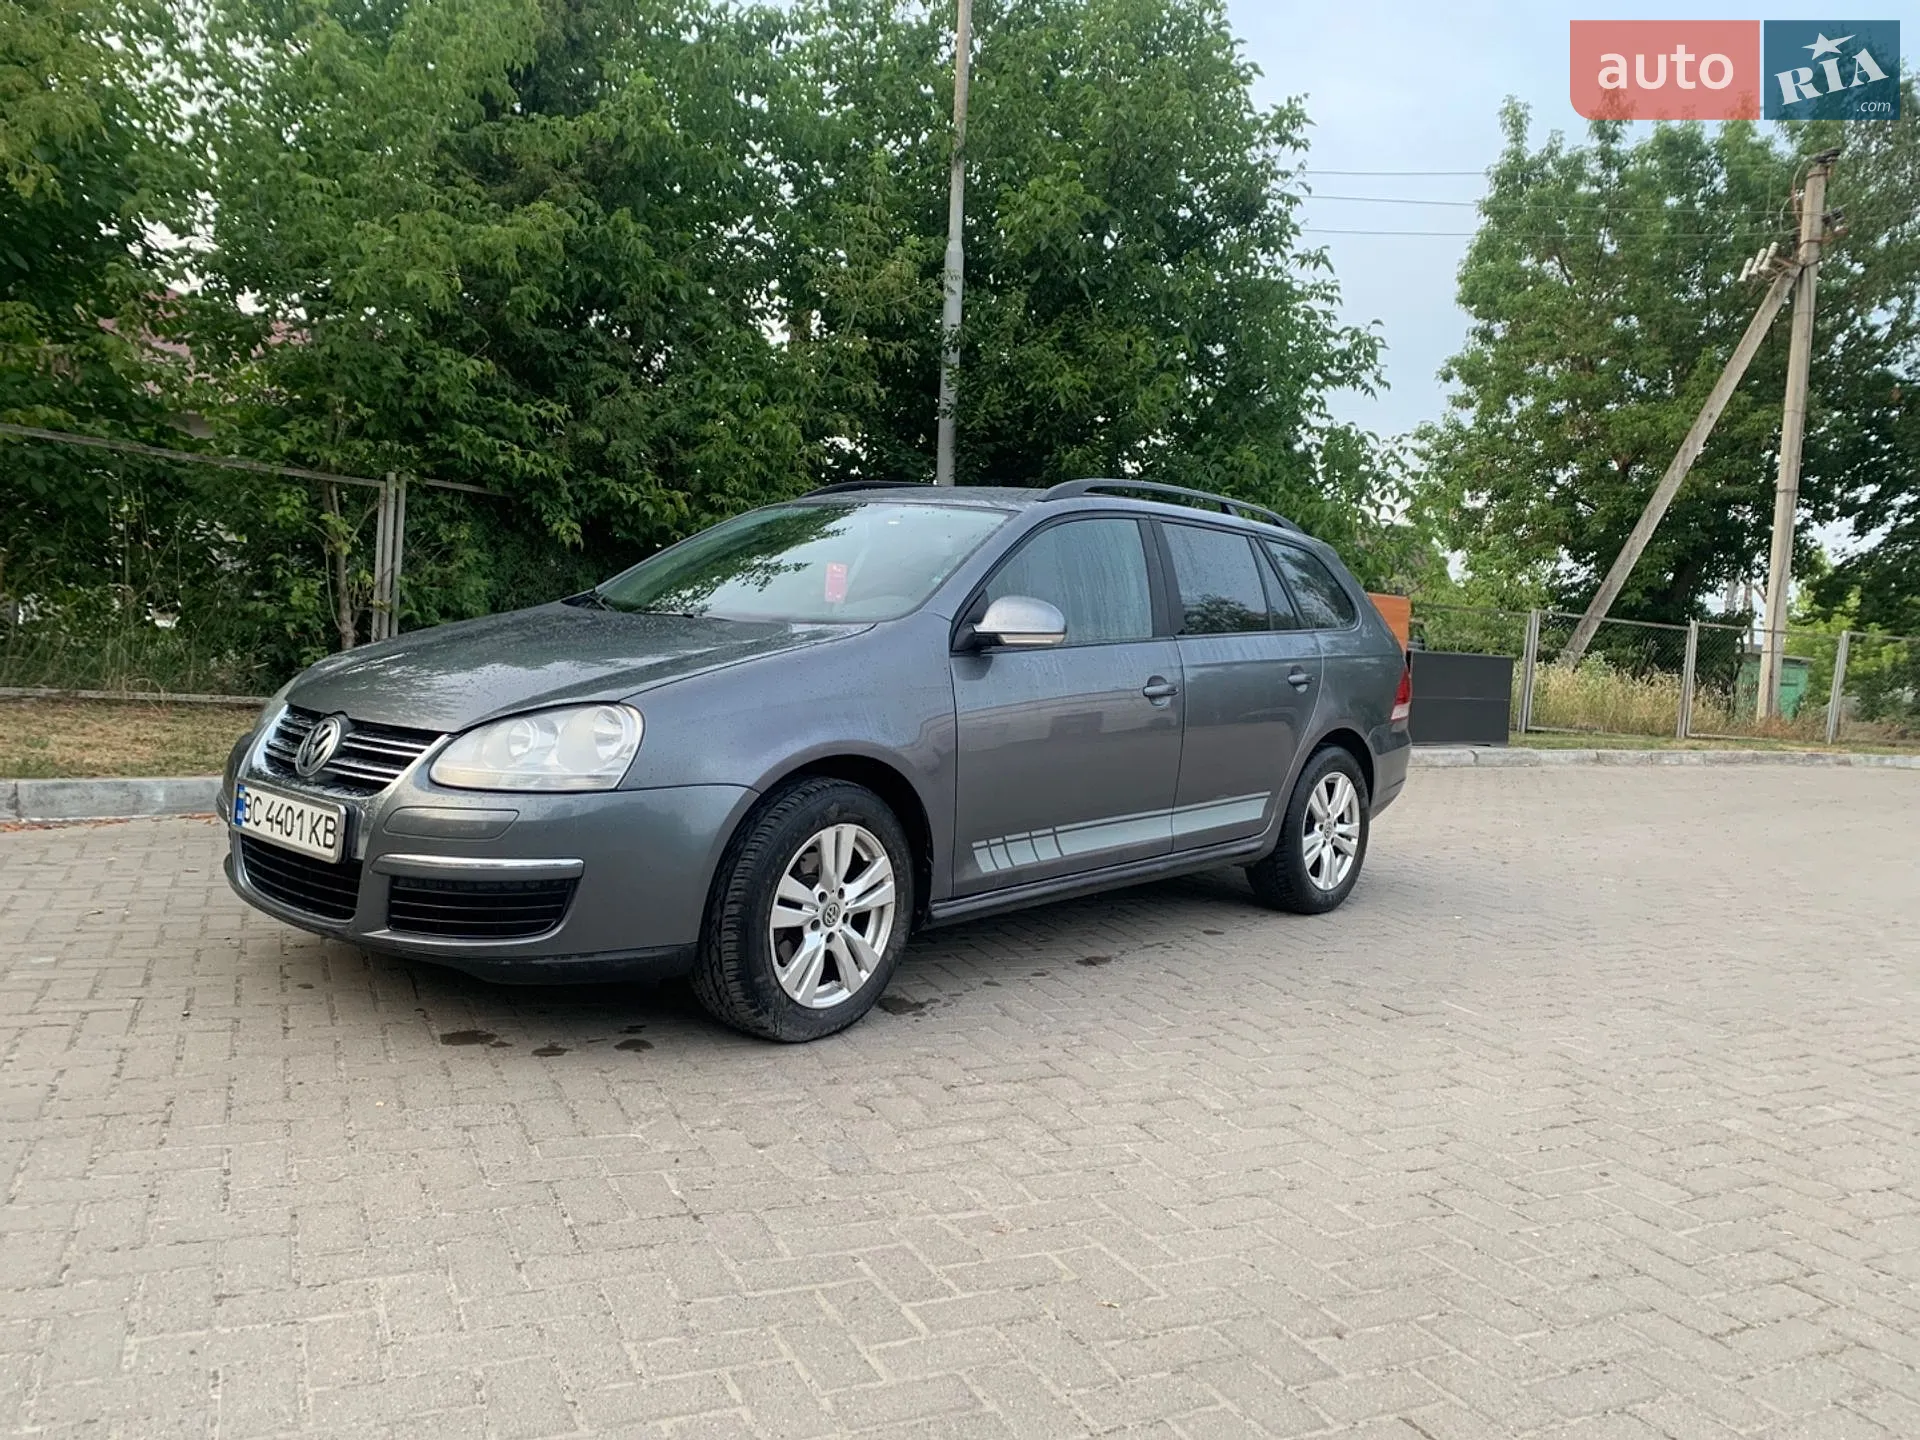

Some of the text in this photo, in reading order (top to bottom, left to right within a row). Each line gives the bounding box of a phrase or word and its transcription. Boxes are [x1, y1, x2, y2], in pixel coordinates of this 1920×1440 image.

[243, 792, 337, 849] BC 4401 KB
